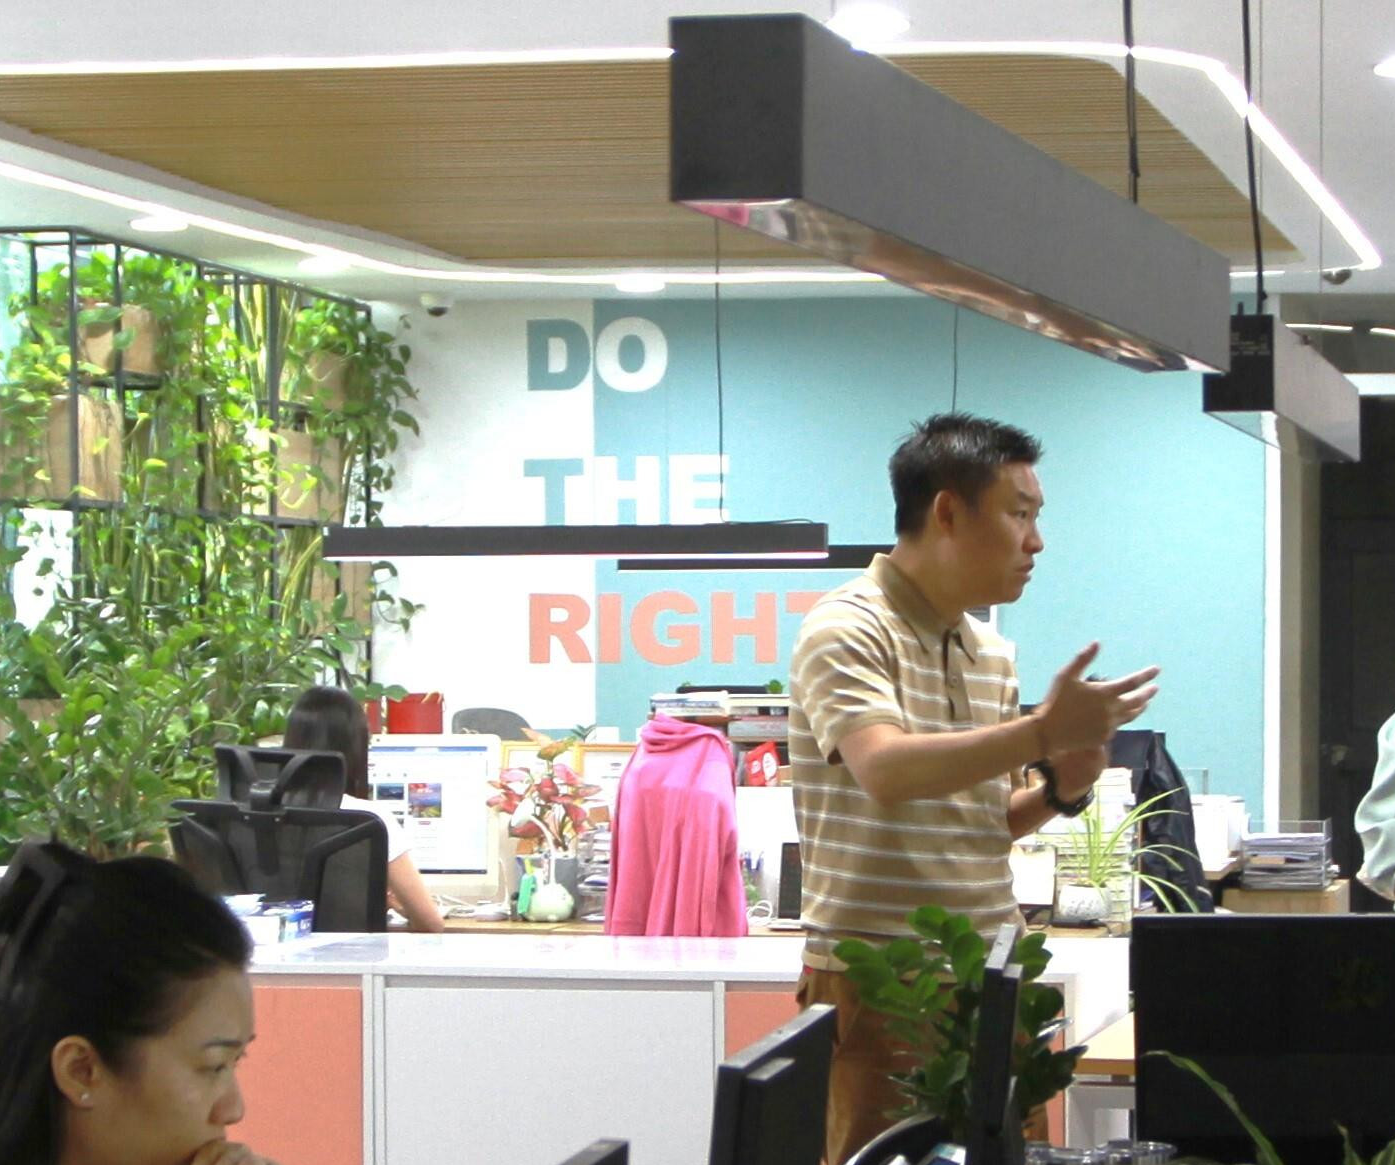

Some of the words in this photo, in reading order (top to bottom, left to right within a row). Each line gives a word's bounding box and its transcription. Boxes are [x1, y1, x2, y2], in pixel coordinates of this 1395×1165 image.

[526, 316, 669, 393] DO
[523, 454, 730, 526] THE
[528, 590, 830, 666] RIGH
